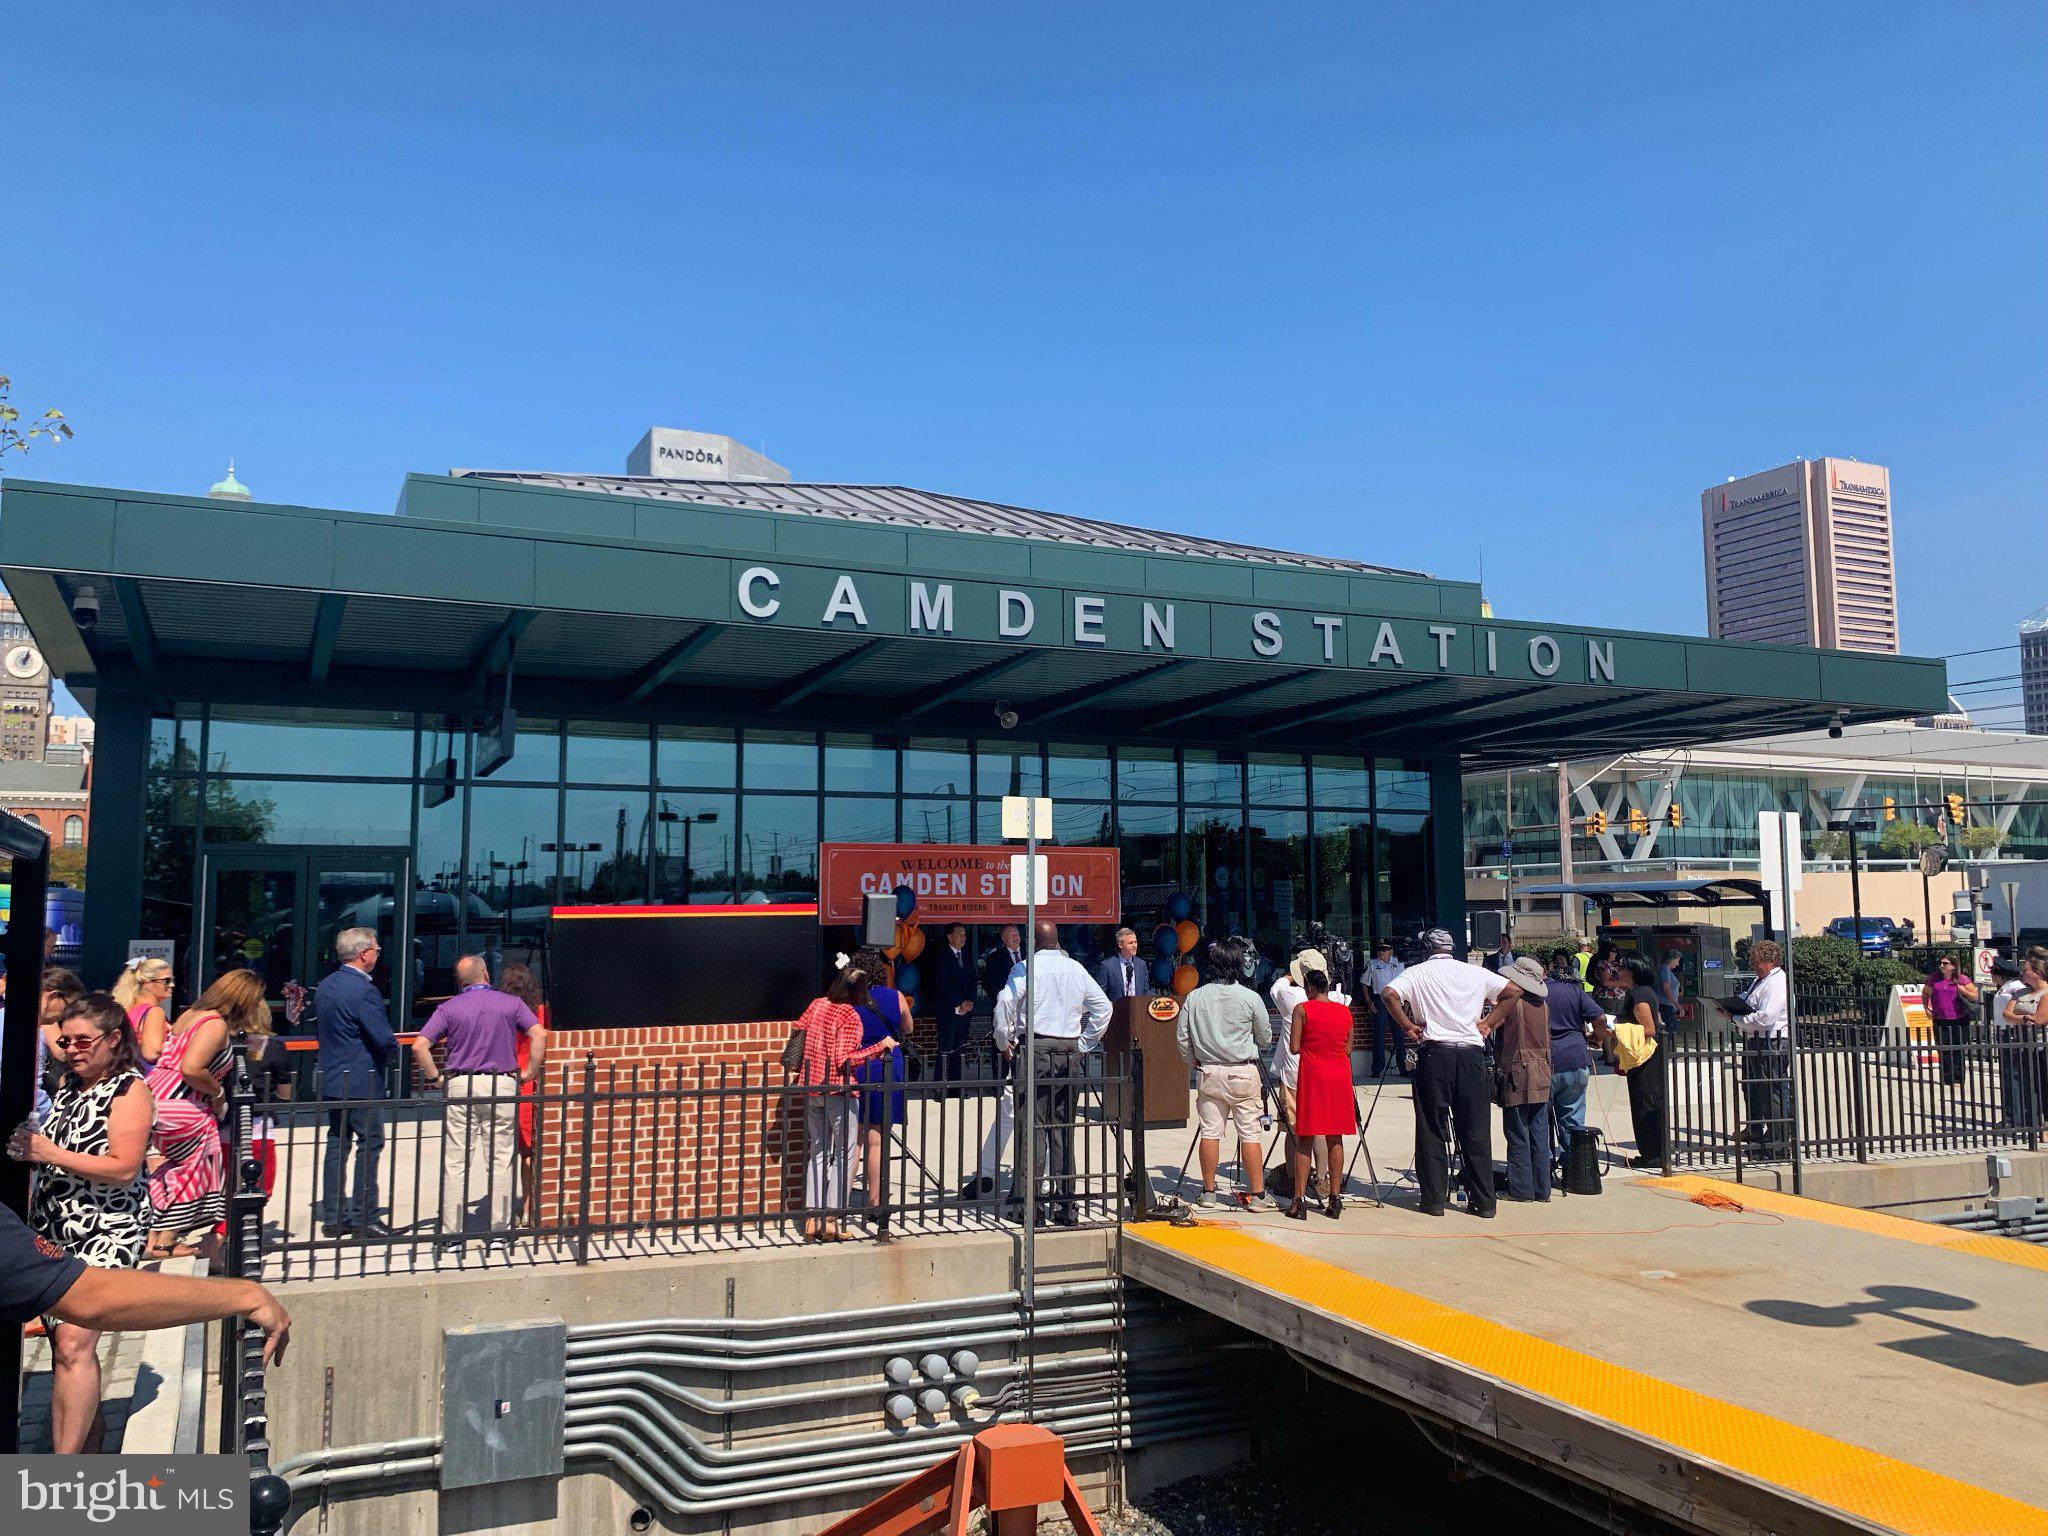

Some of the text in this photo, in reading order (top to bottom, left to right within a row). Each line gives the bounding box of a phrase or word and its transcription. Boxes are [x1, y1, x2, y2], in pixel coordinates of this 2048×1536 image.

[738, 567, 1616, 682] CAMDEN STATION
[901, 857, 1010, 871] WELCOME to the
[860, 872, 1083, 896] CAMDEN STON
[928, 903, 960, 911] TRANSIT
[961, 903, 988, 911] RIDERS
